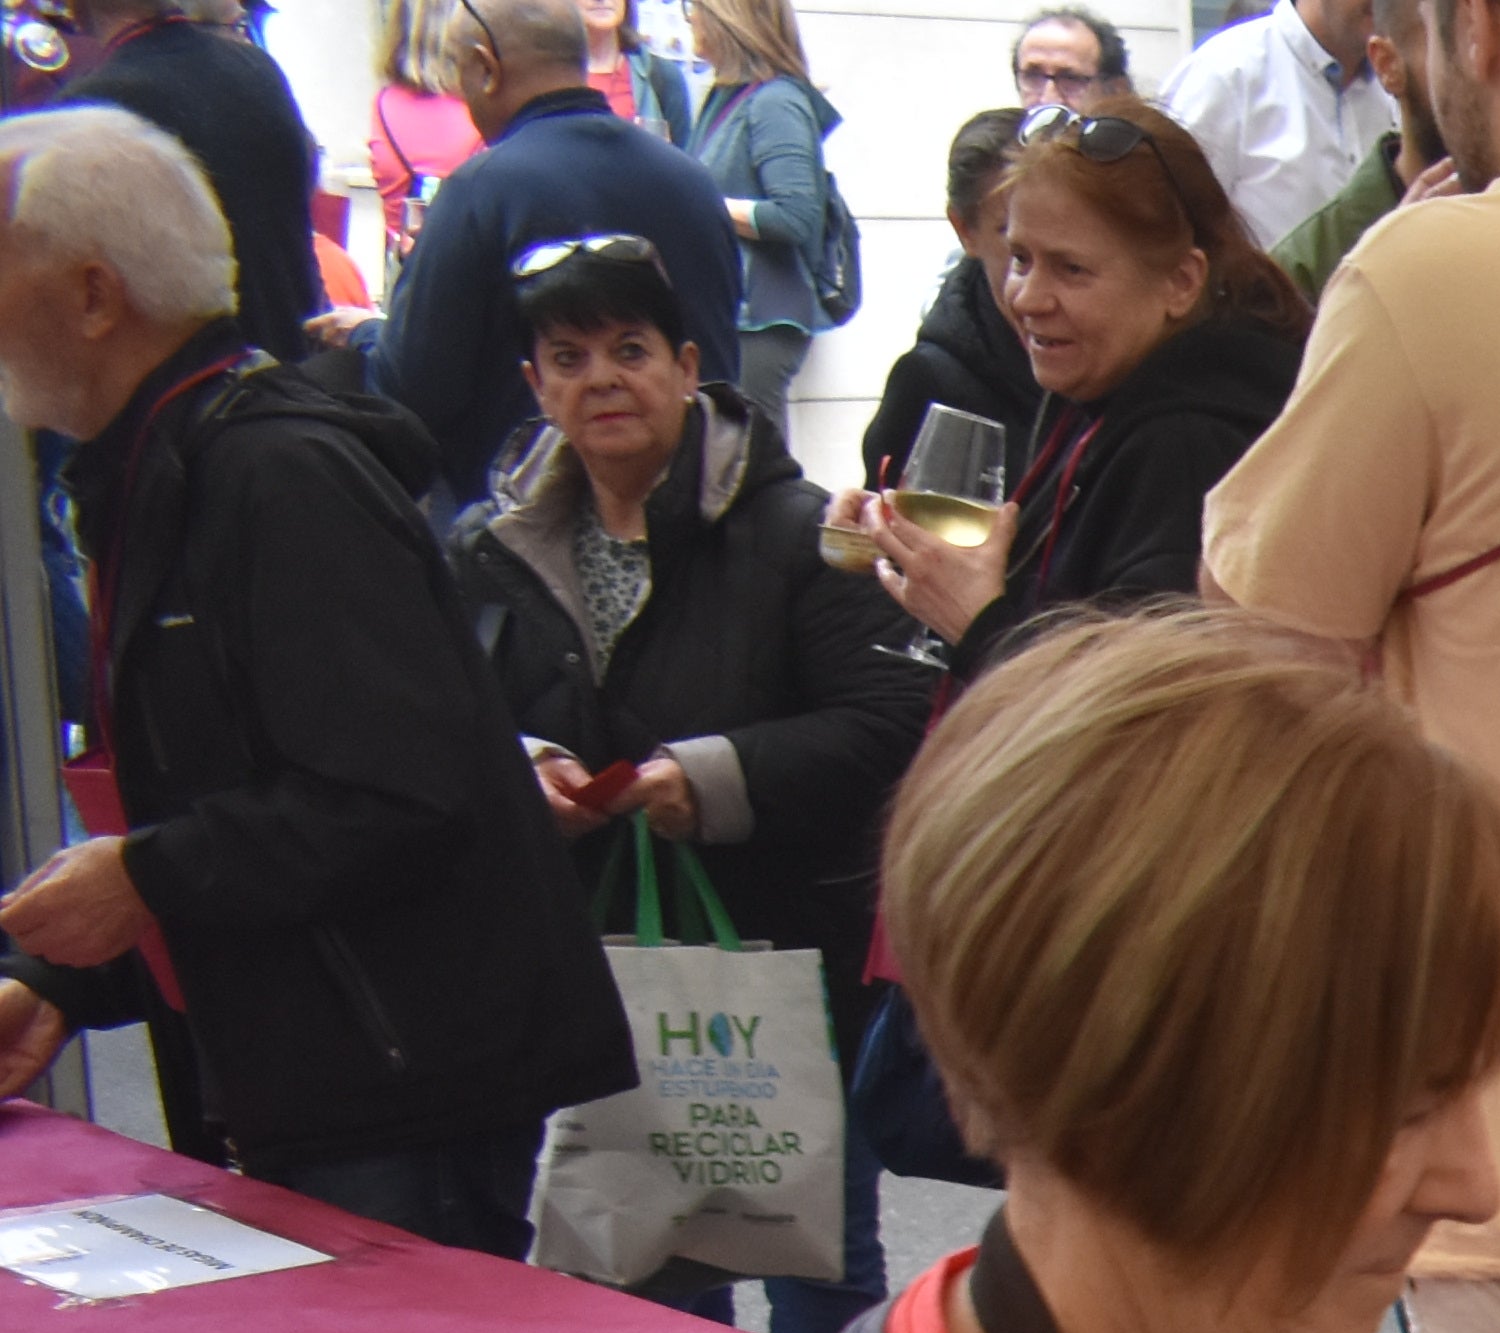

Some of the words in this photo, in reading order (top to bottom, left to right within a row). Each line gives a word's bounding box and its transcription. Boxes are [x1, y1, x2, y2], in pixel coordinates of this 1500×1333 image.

[688, 1103, 762, 1128] PARA
[648, 1131, 804, 1158] RECICLAR
[672, 1159, 783, 1185] VIDRIO
